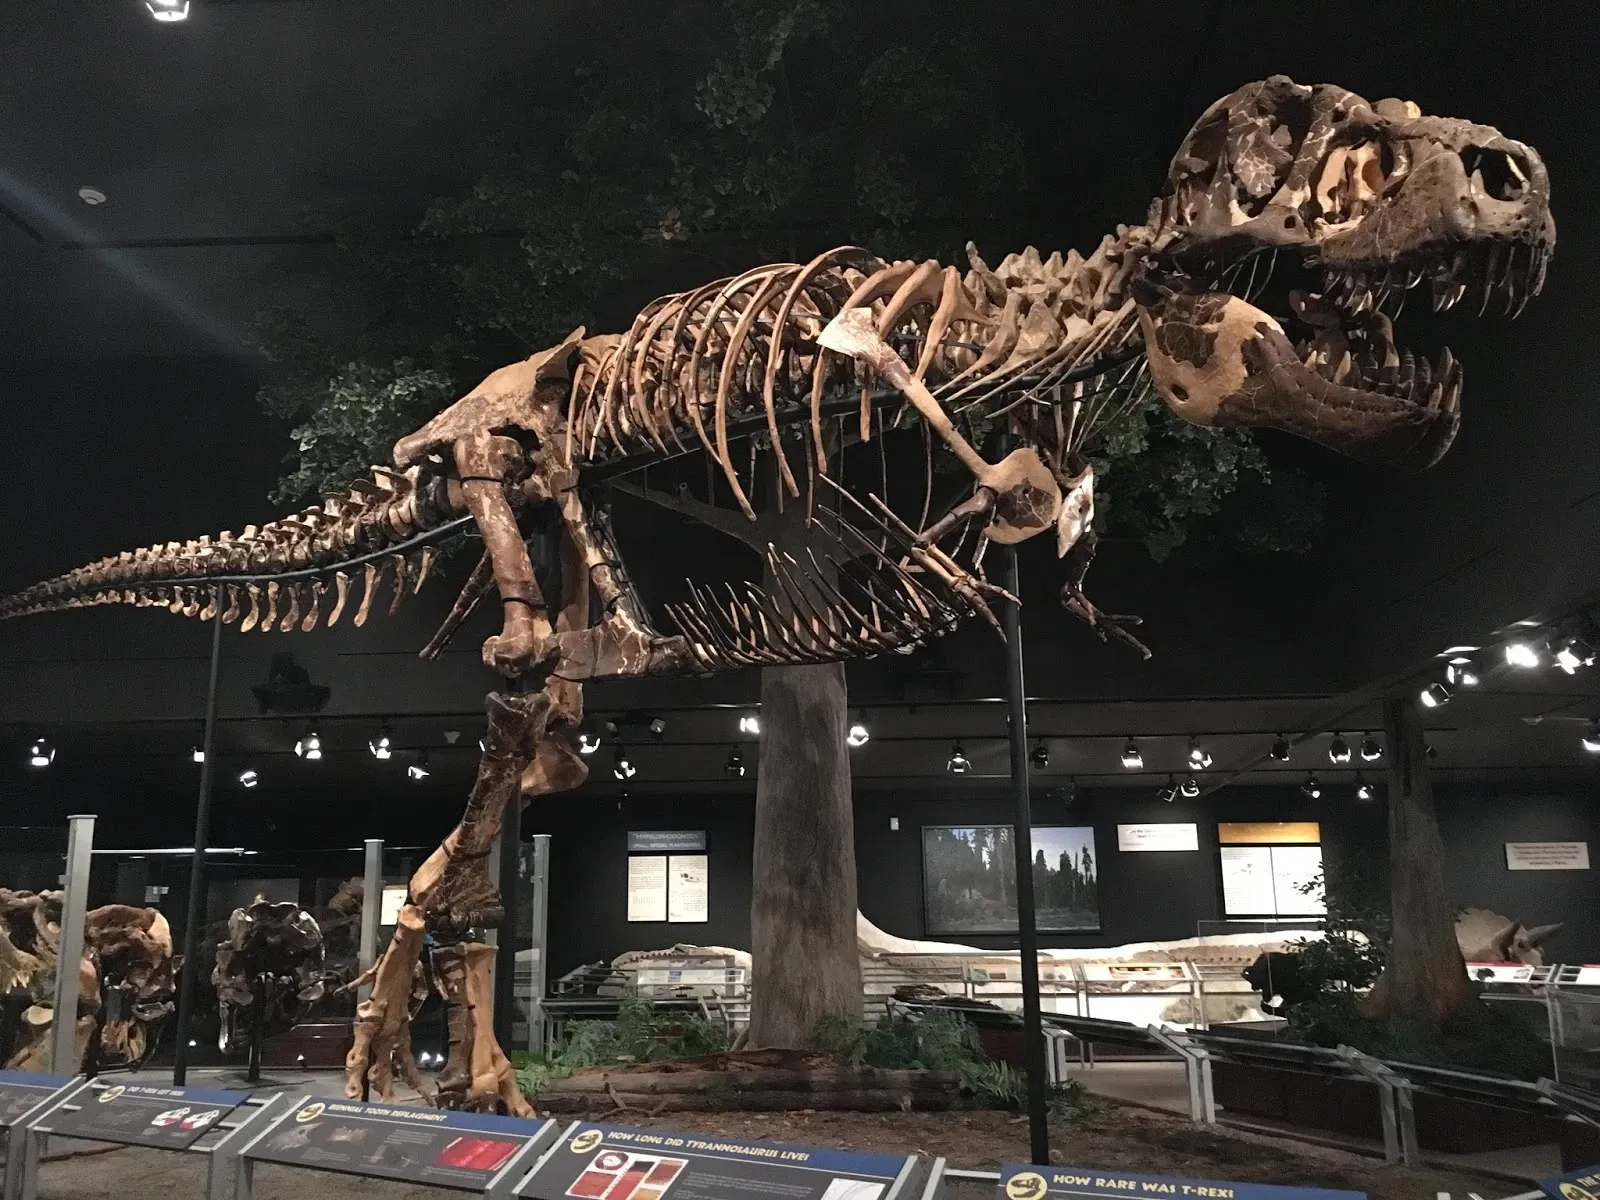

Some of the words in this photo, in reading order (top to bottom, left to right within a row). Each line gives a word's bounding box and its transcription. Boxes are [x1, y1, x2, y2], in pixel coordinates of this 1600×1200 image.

[364, 1107, 391, 1116] TOOTH
[390, 1110, 448, 1122] REPLACEMENT
[607, 1131, 635, 1140] HOW
[634, 1134, 664, 1144] LONG
[664, 1137, 684, 1147] DID
[686, 1140, 779, 1158] TYRANNOSAURUS
[1053, 1174, 1091, 1186] HOW
[1095, 1178, 1137, 1190] RARE
[1141, 1182, 1176, 1194] WAS
